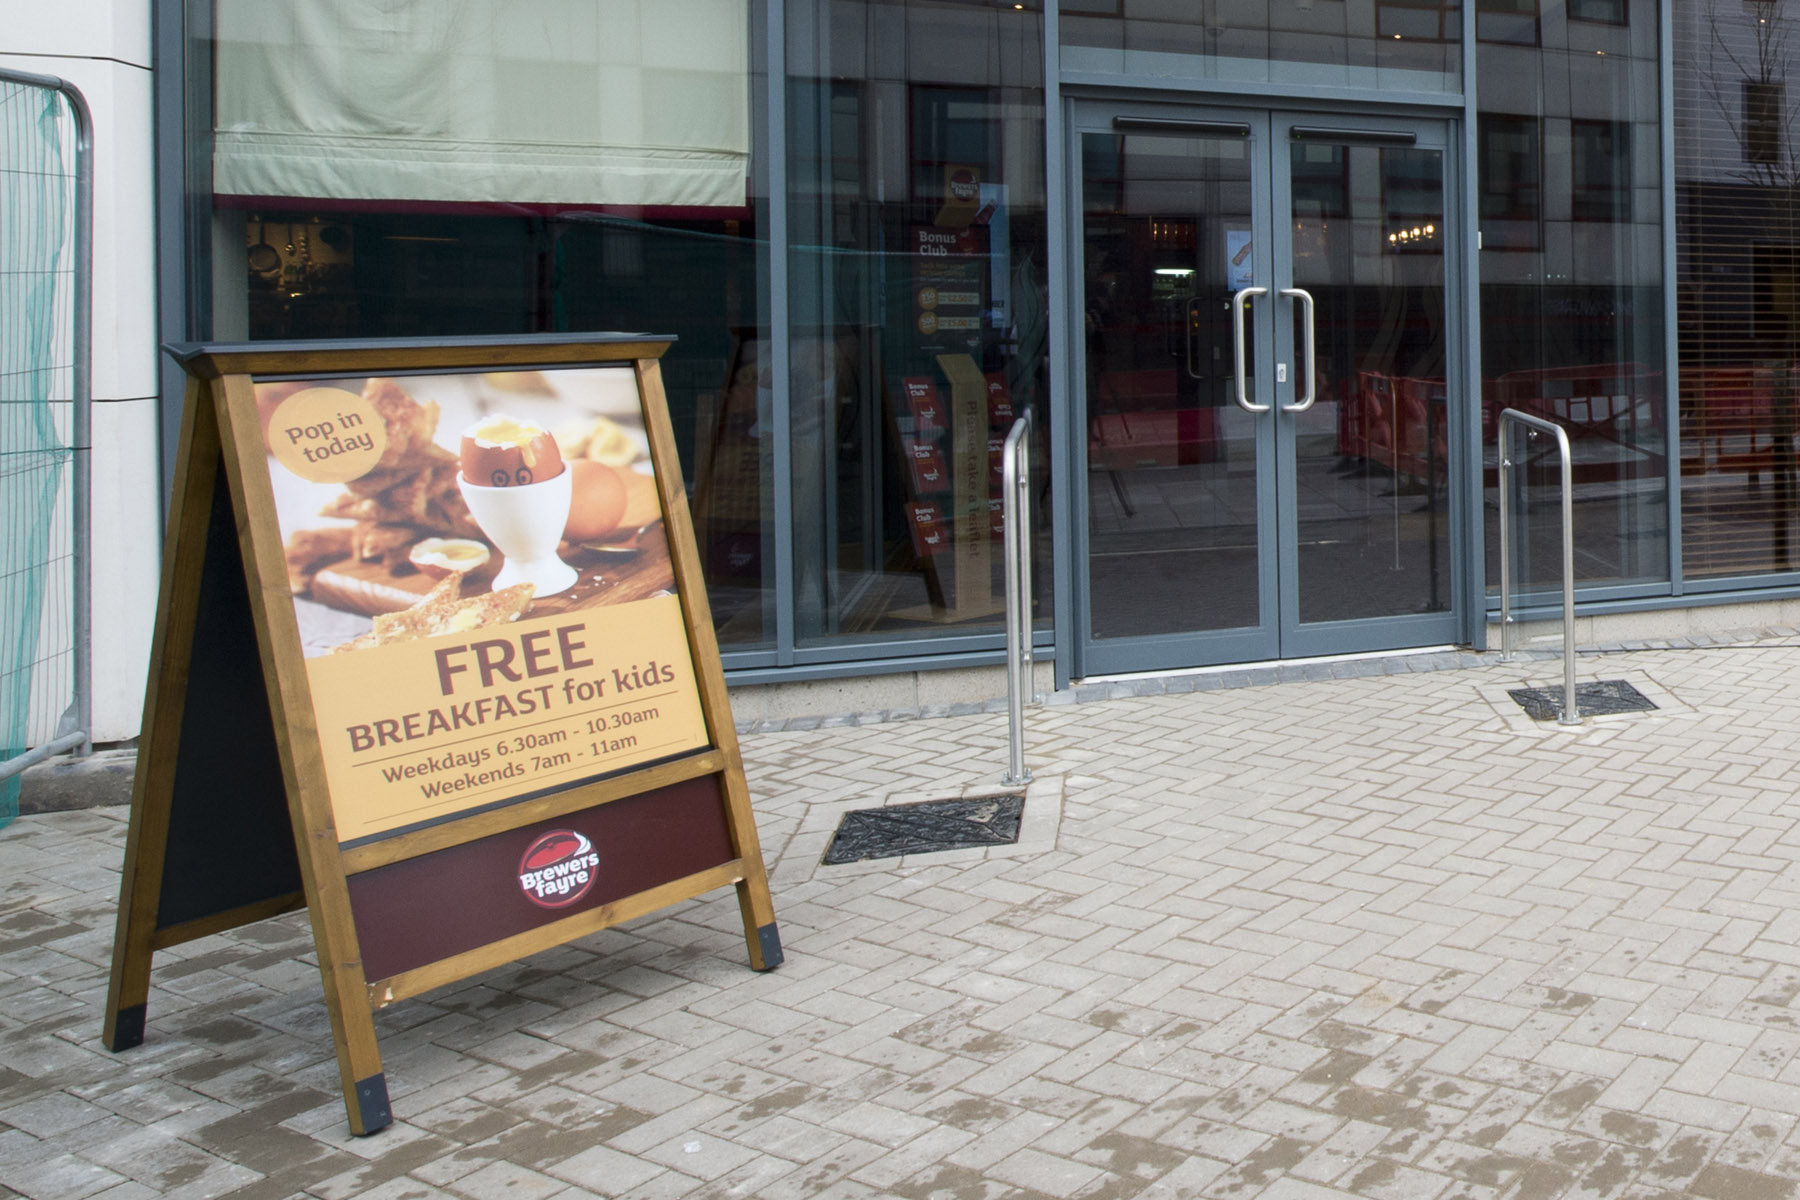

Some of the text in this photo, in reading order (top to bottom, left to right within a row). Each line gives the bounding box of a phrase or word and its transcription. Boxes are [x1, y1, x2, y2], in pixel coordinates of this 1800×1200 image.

[919, 231, 957, 244] Bonus
[919, 244, 948, 257] Club
[910, 389, 926, 397] Club
[285, 412, 363, 445] Pop in
[303, 432, 375, 463] today
[915, 451, 930, 459] Club
[967, 455, 980, 490] take
[916, 514, 932, 522] Club
[434, 623, 594, 696] FREE
[346, 661, 676, 753] BREAKFAST for kids
[382, 748, 491, 784] Weekdays
[496, 726, 568, 757] 6.30am
[586, 705, 660, 736] 10.30am
[420, 762, 526, 800] Weekends
[531, 751, 572, 772] 7am
[591, 733, 638, 757] 11am
[520, 853, 600, 890] Brewers
[535, 870, 589, 898] fayre
